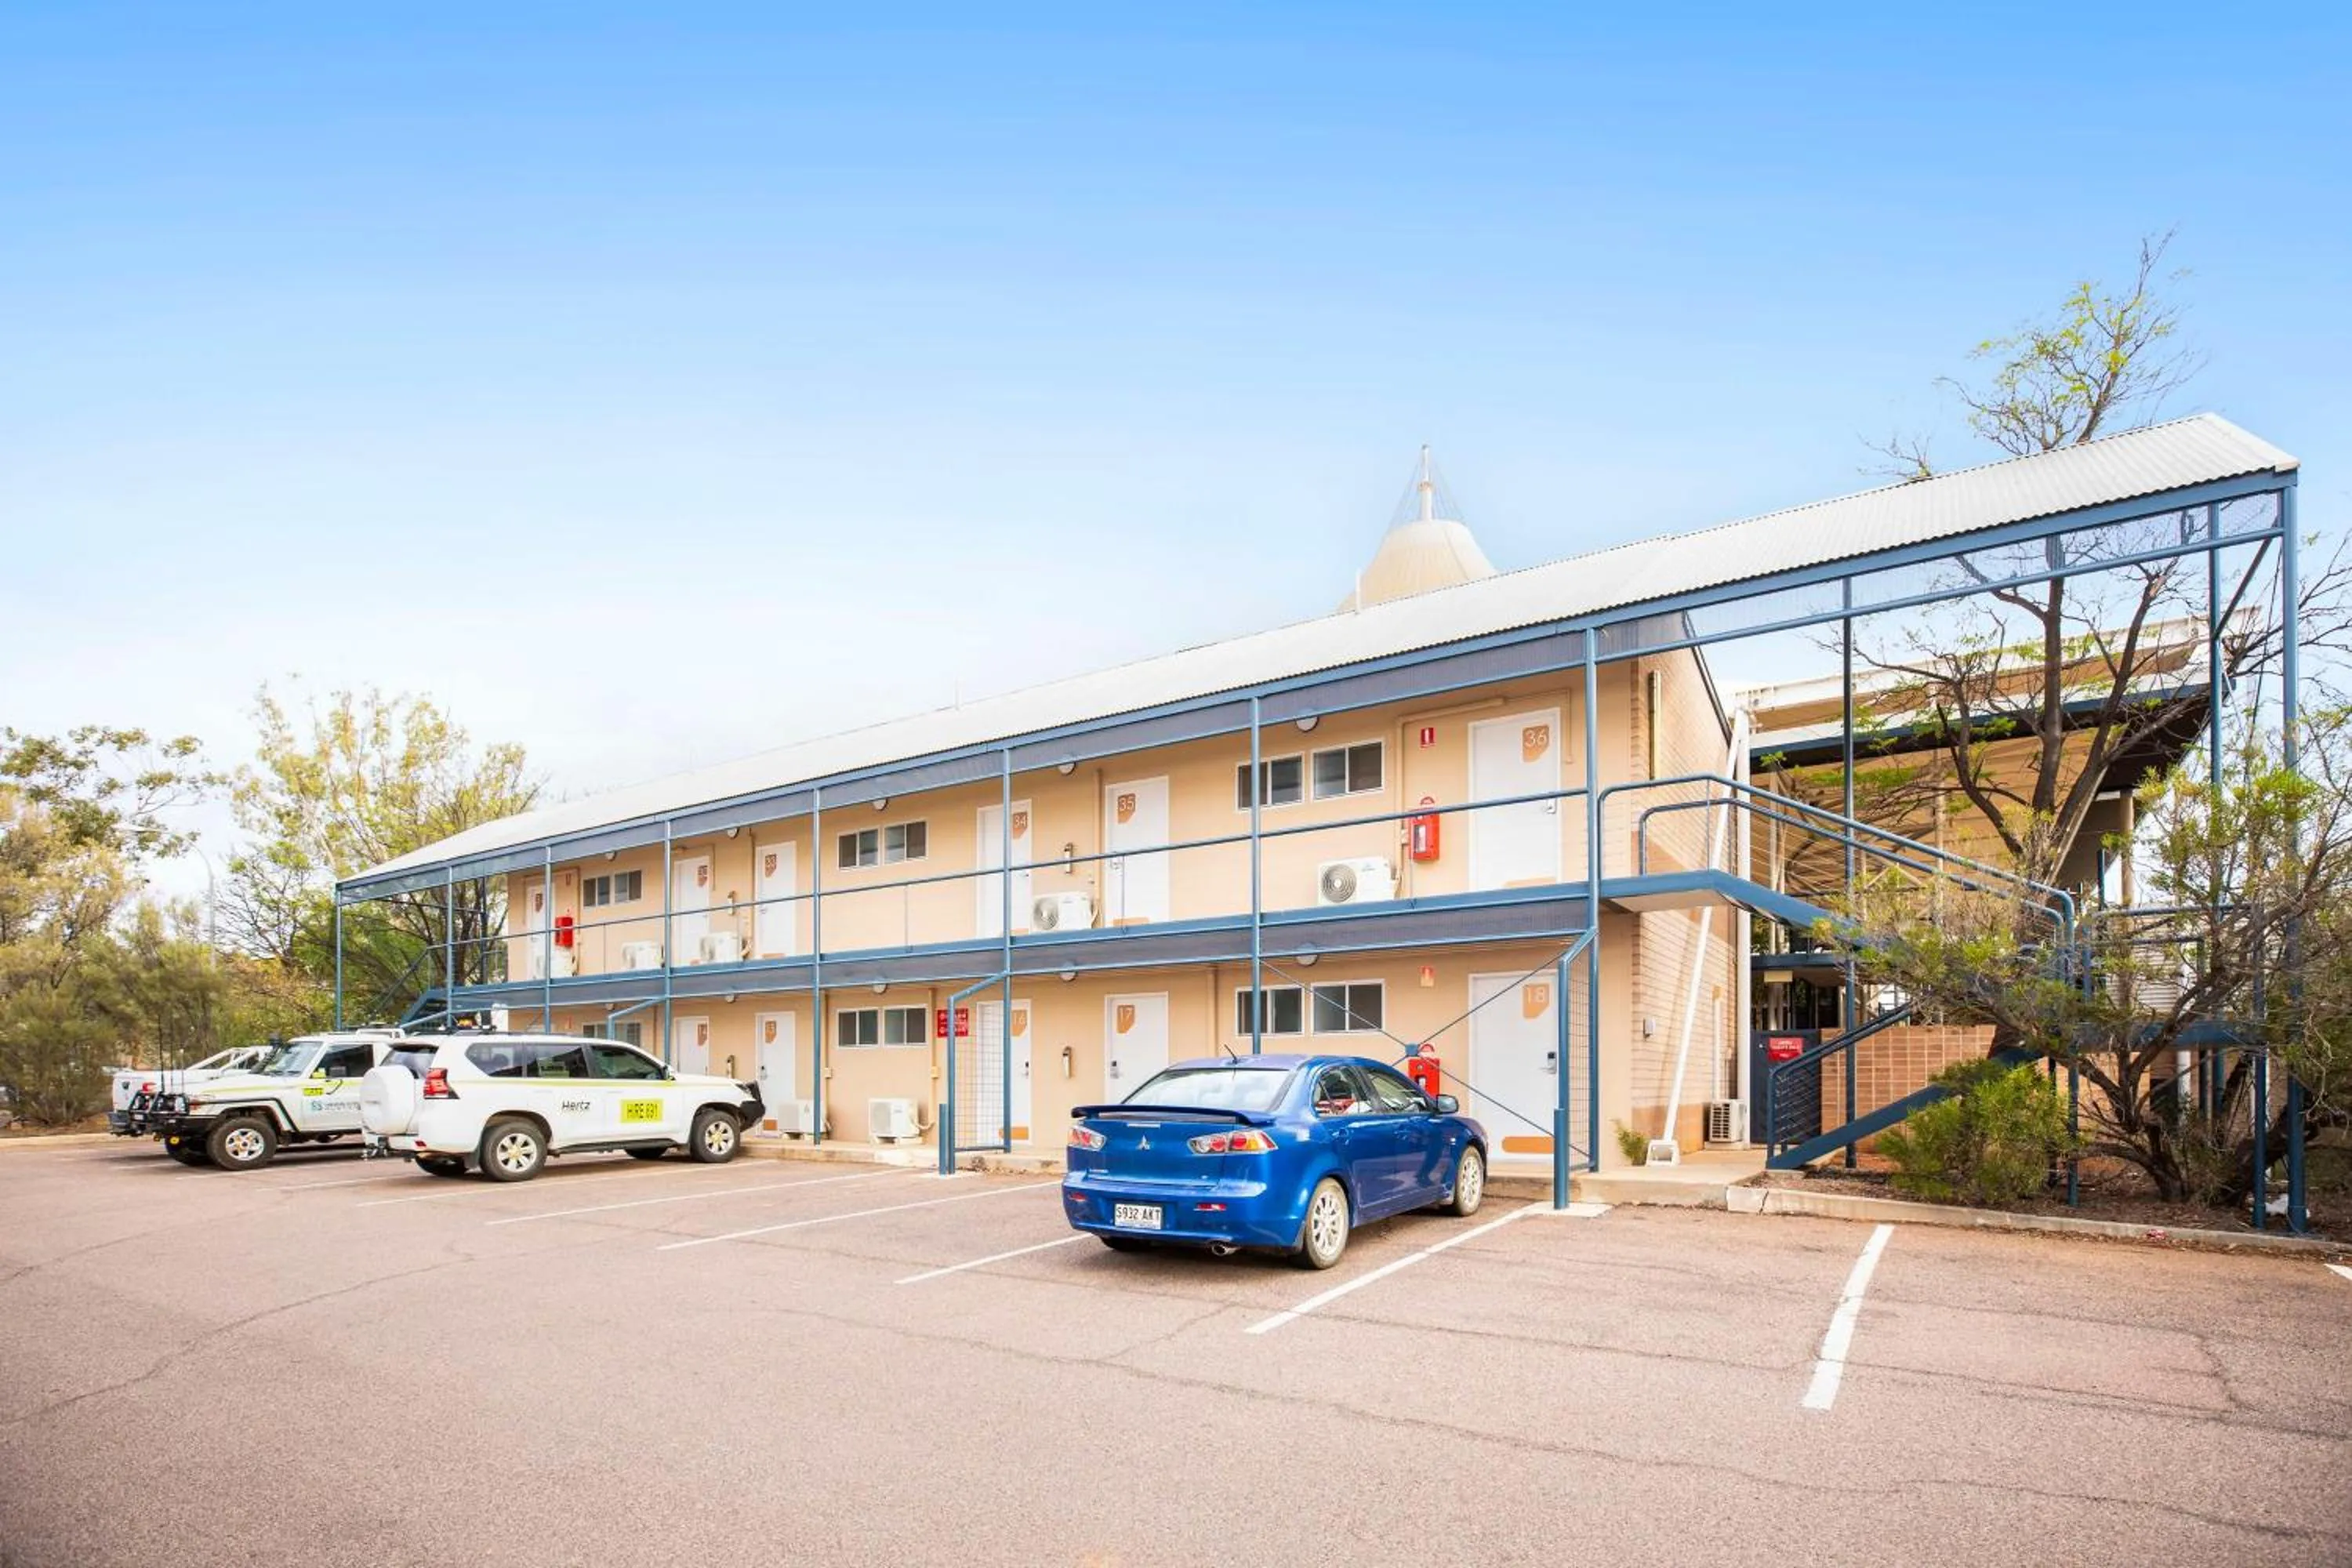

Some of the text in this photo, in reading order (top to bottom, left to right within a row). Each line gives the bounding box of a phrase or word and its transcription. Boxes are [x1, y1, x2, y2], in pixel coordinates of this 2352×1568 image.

[1525, 729, 1548, 746] 36
[1119, 796, 1134, 811] 35
[1014, 815, 1026, 828] 34
[1526, 987, 1547, 1003] 18
[1014, 1012, 1025, 1025] 16
[1120, 1007, 1133, 1022] 17
[561, 1100, 590, 1111] Hertz
[1116, 1207, 1160, 1220] S932 AKT
